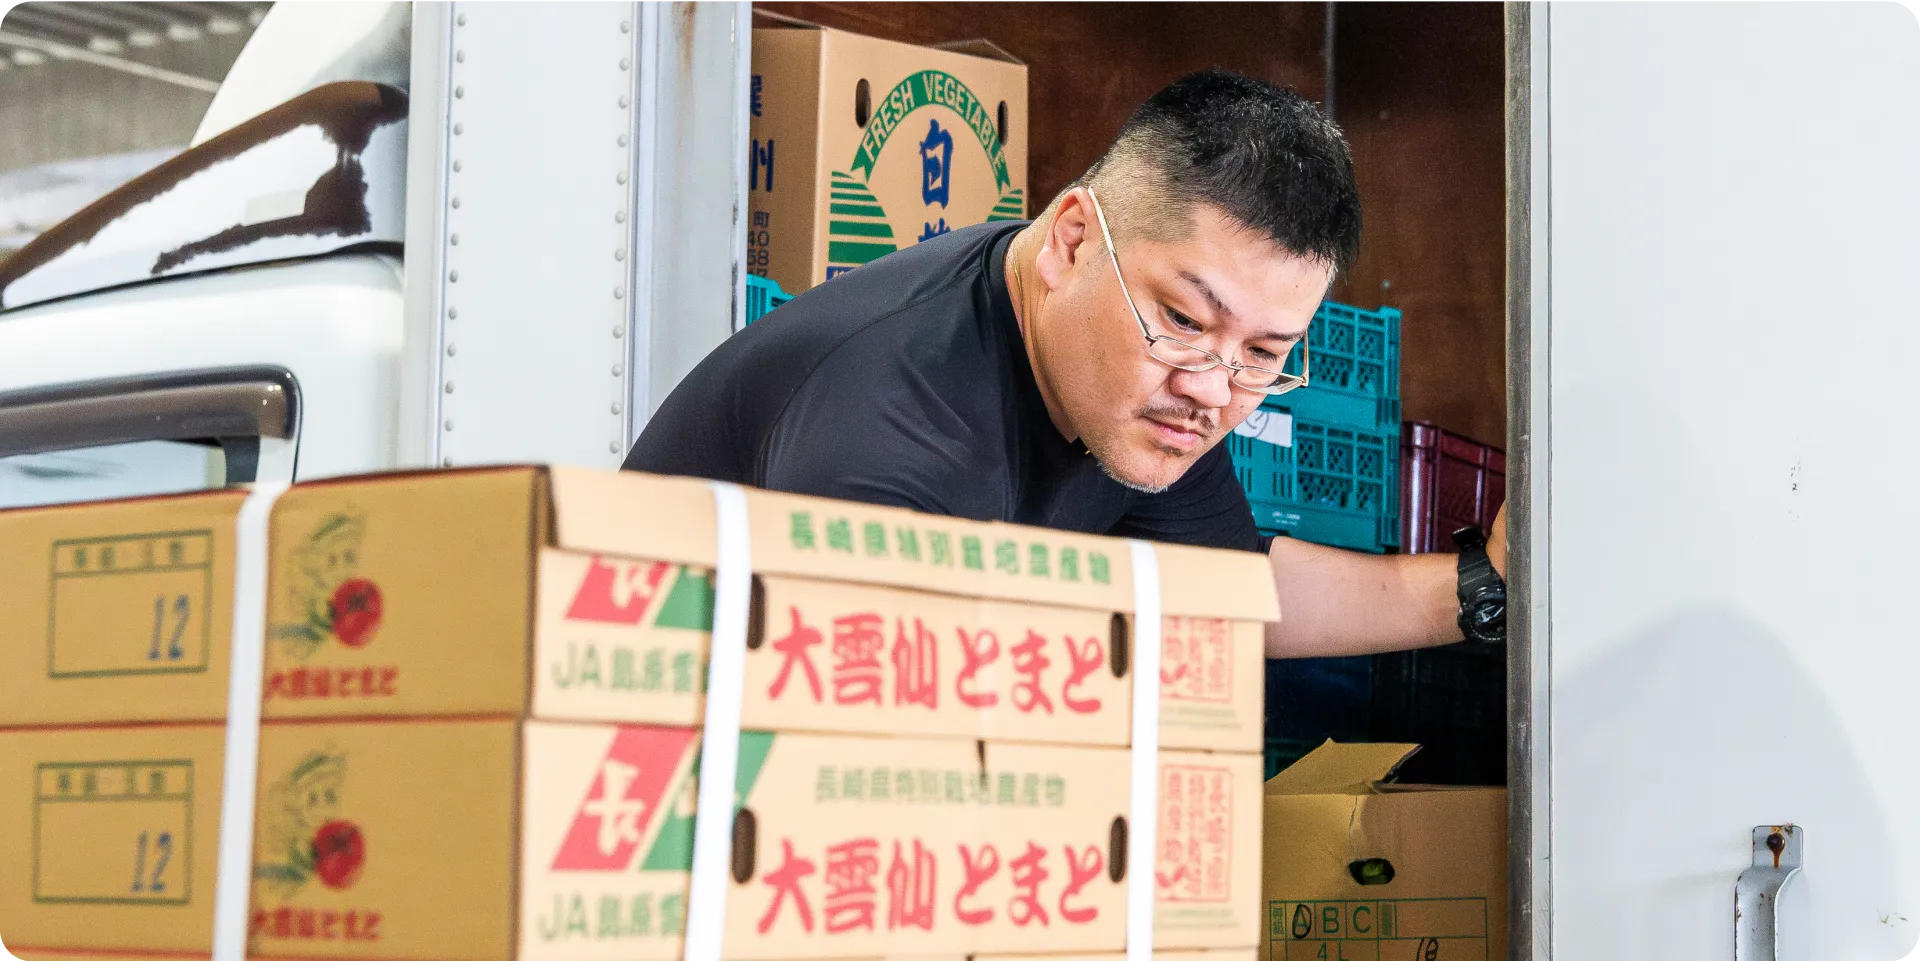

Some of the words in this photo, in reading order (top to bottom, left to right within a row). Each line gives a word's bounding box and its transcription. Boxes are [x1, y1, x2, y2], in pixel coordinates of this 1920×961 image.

[862, 80, 914, 163] FRESH
[922, 72, 1006, 174] VEGETABLE
[148, 594, 190, 661] 12
[768, 605, 1105, 716] 大雲仙とまと
[131, 829, 173, 892] 12
[757, 836, 1105, 934] 大雲仙とまと
[1322, 906, 1340, 933] B
[1353, 905, 1372, 933] C
